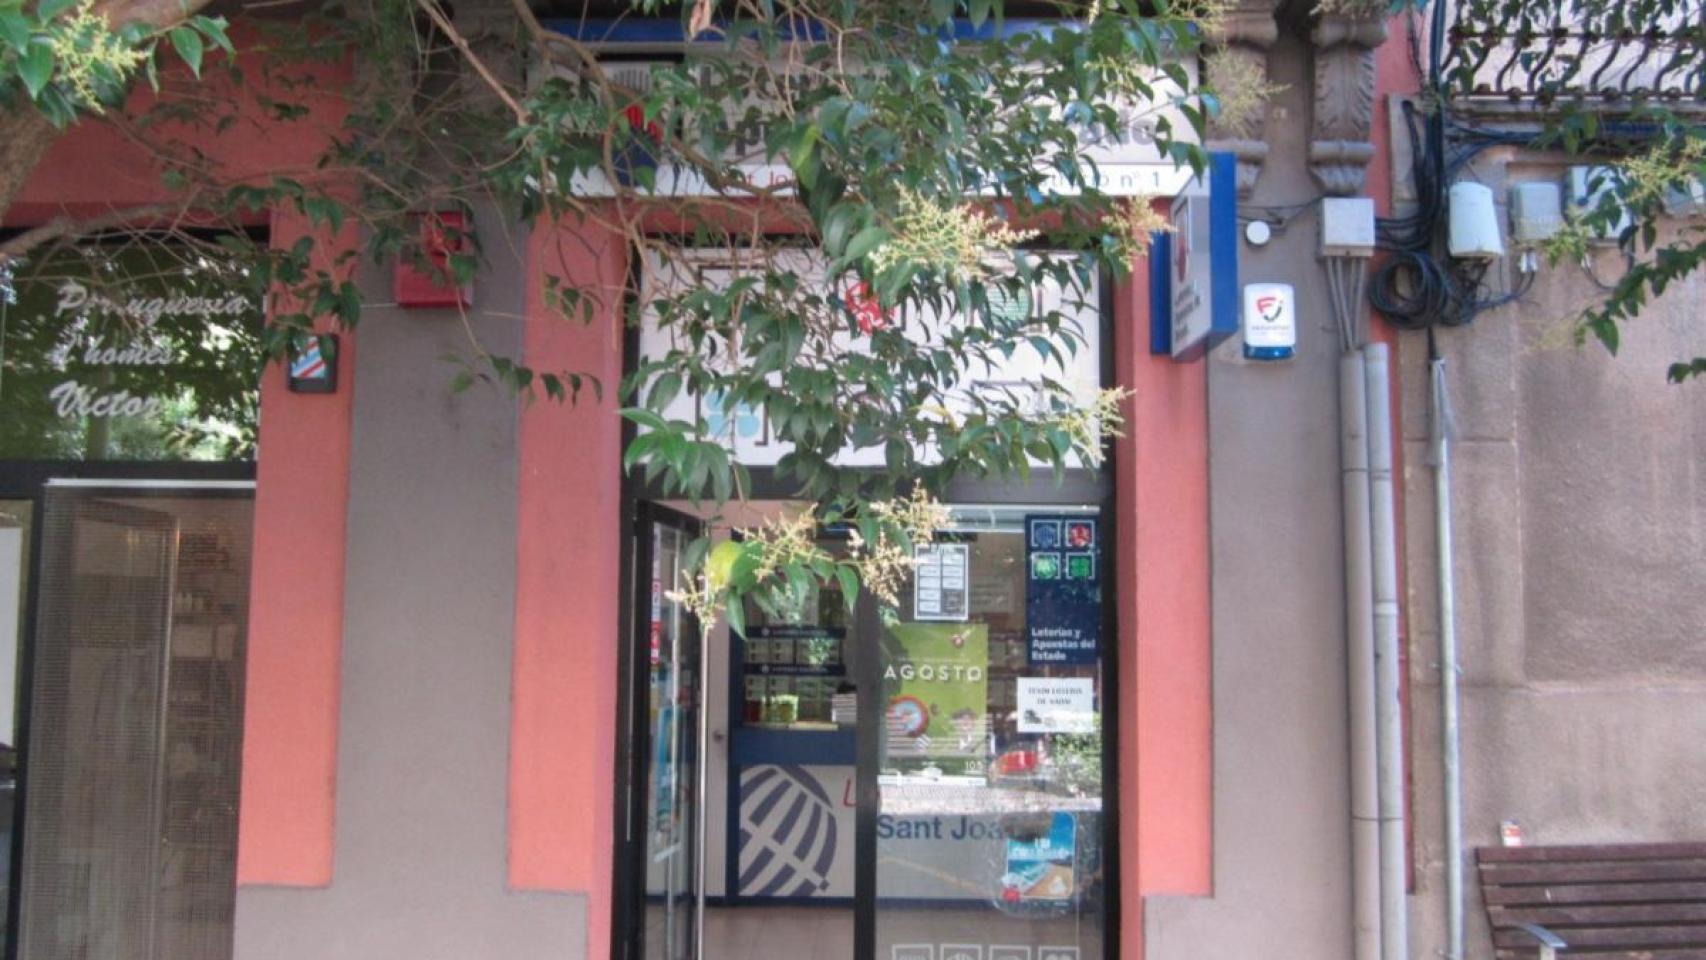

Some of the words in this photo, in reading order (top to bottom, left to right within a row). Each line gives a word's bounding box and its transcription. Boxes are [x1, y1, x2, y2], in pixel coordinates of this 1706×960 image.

[1032, 650, 1066, 661] Estado
[883, 664, 982, 681] AGOSTO
[876, 815, 942, 839] Sant
[951, 815, 1004, 839] Joa
